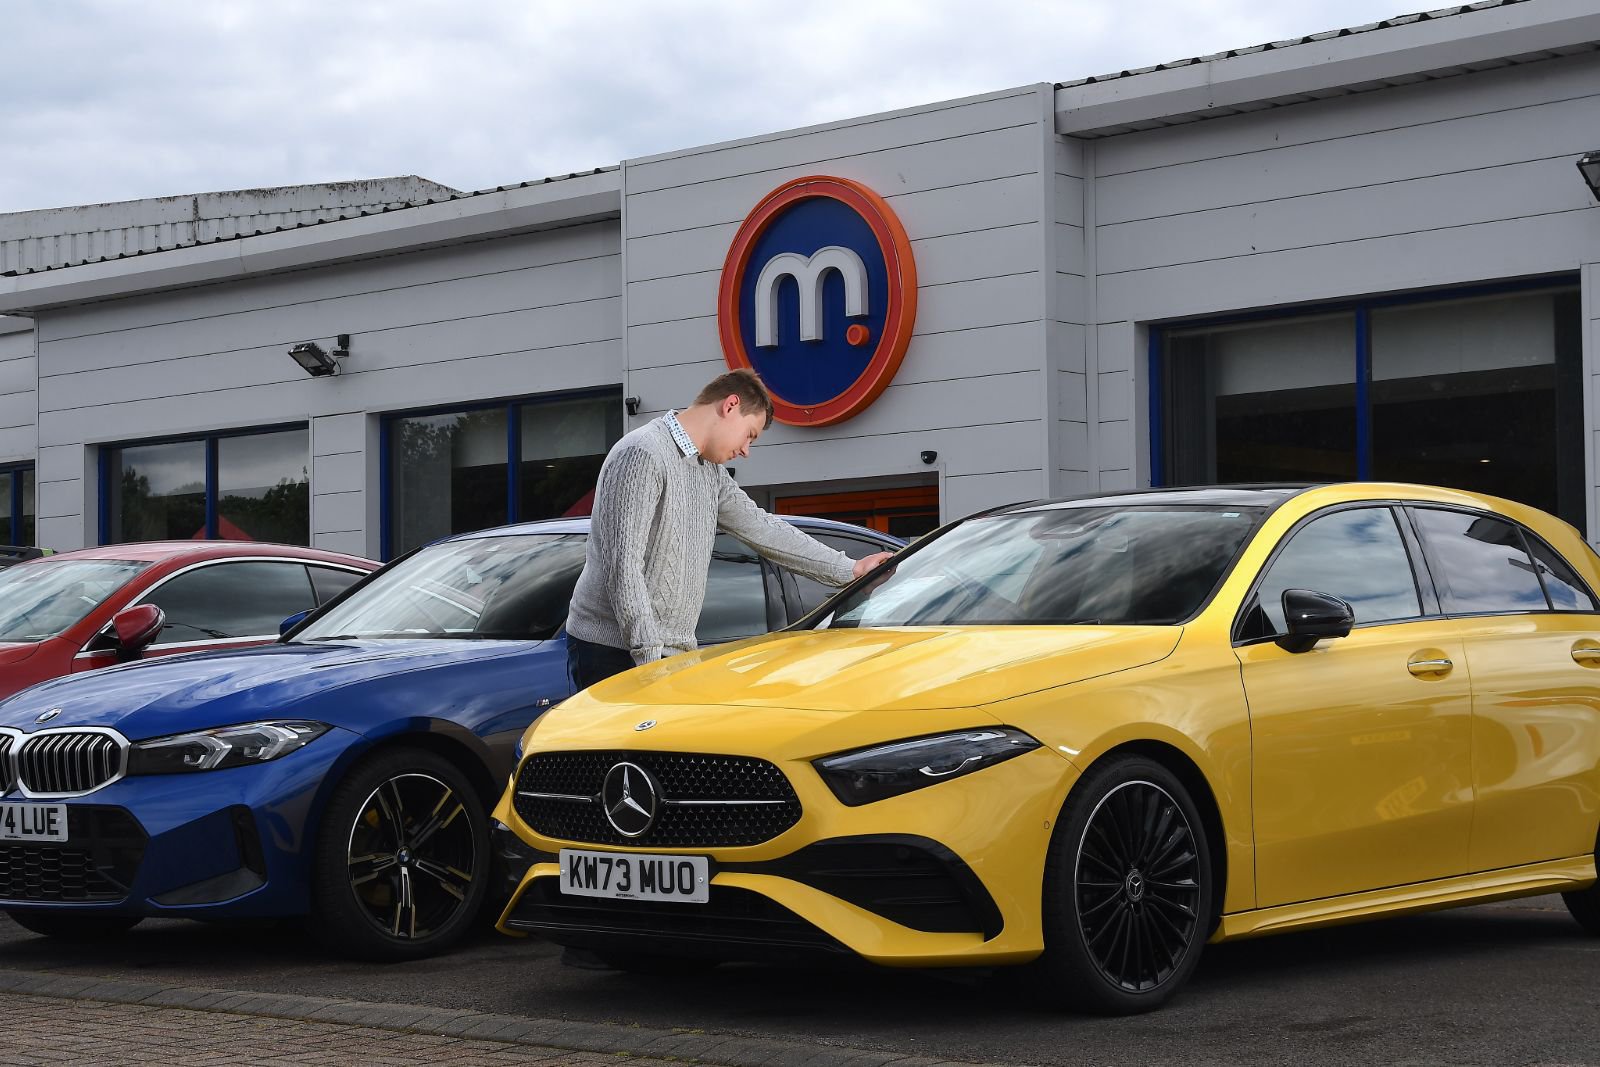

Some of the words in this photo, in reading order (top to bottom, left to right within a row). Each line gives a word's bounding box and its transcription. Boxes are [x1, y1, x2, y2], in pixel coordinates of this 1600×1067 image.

[21, 807, 59, 835] LUE
[569, 855, 631, 892] KW73
[639, 859, 695, 895] MUO
